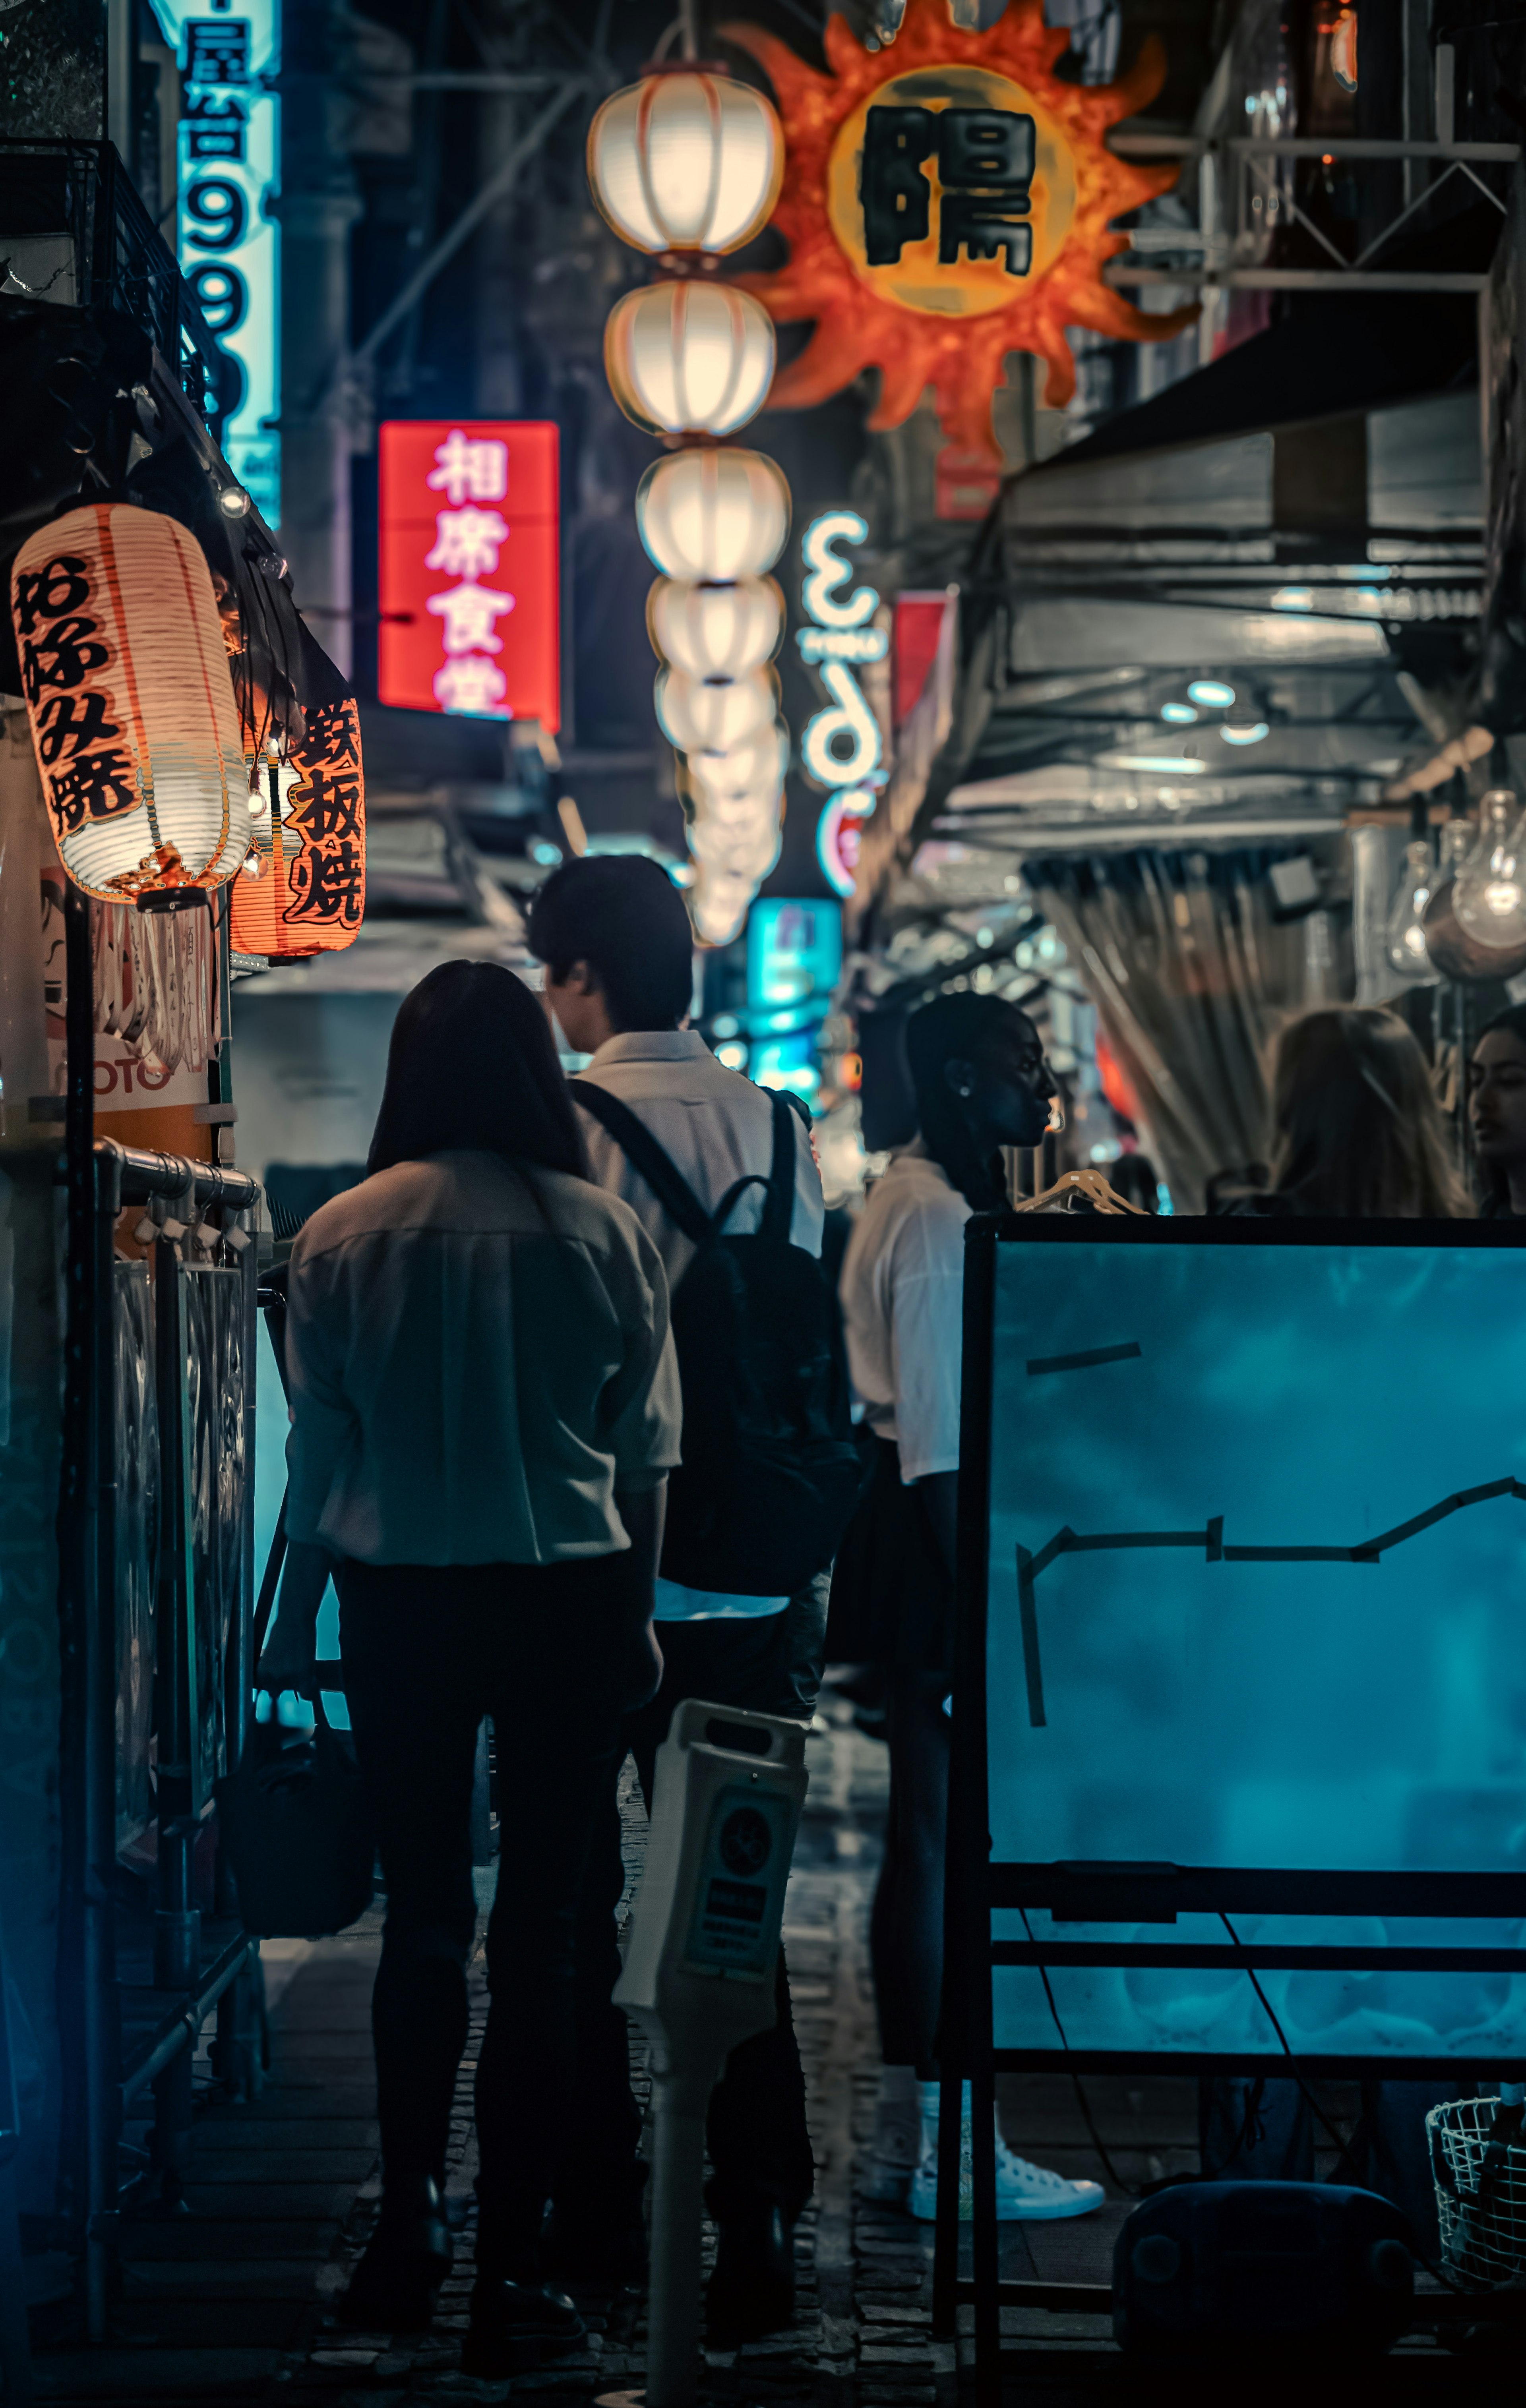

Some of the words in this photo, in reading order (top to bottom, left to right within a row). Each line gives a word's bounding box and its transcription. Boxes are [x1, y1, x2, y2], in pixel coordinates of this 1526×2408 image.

[861, 106, 1036, 276] 陽
[15, 557, 135, 837] お好み焼
[425, 429, 516, 721] 相席食堂
[296, 705, 361, 923] 鉄板焼
